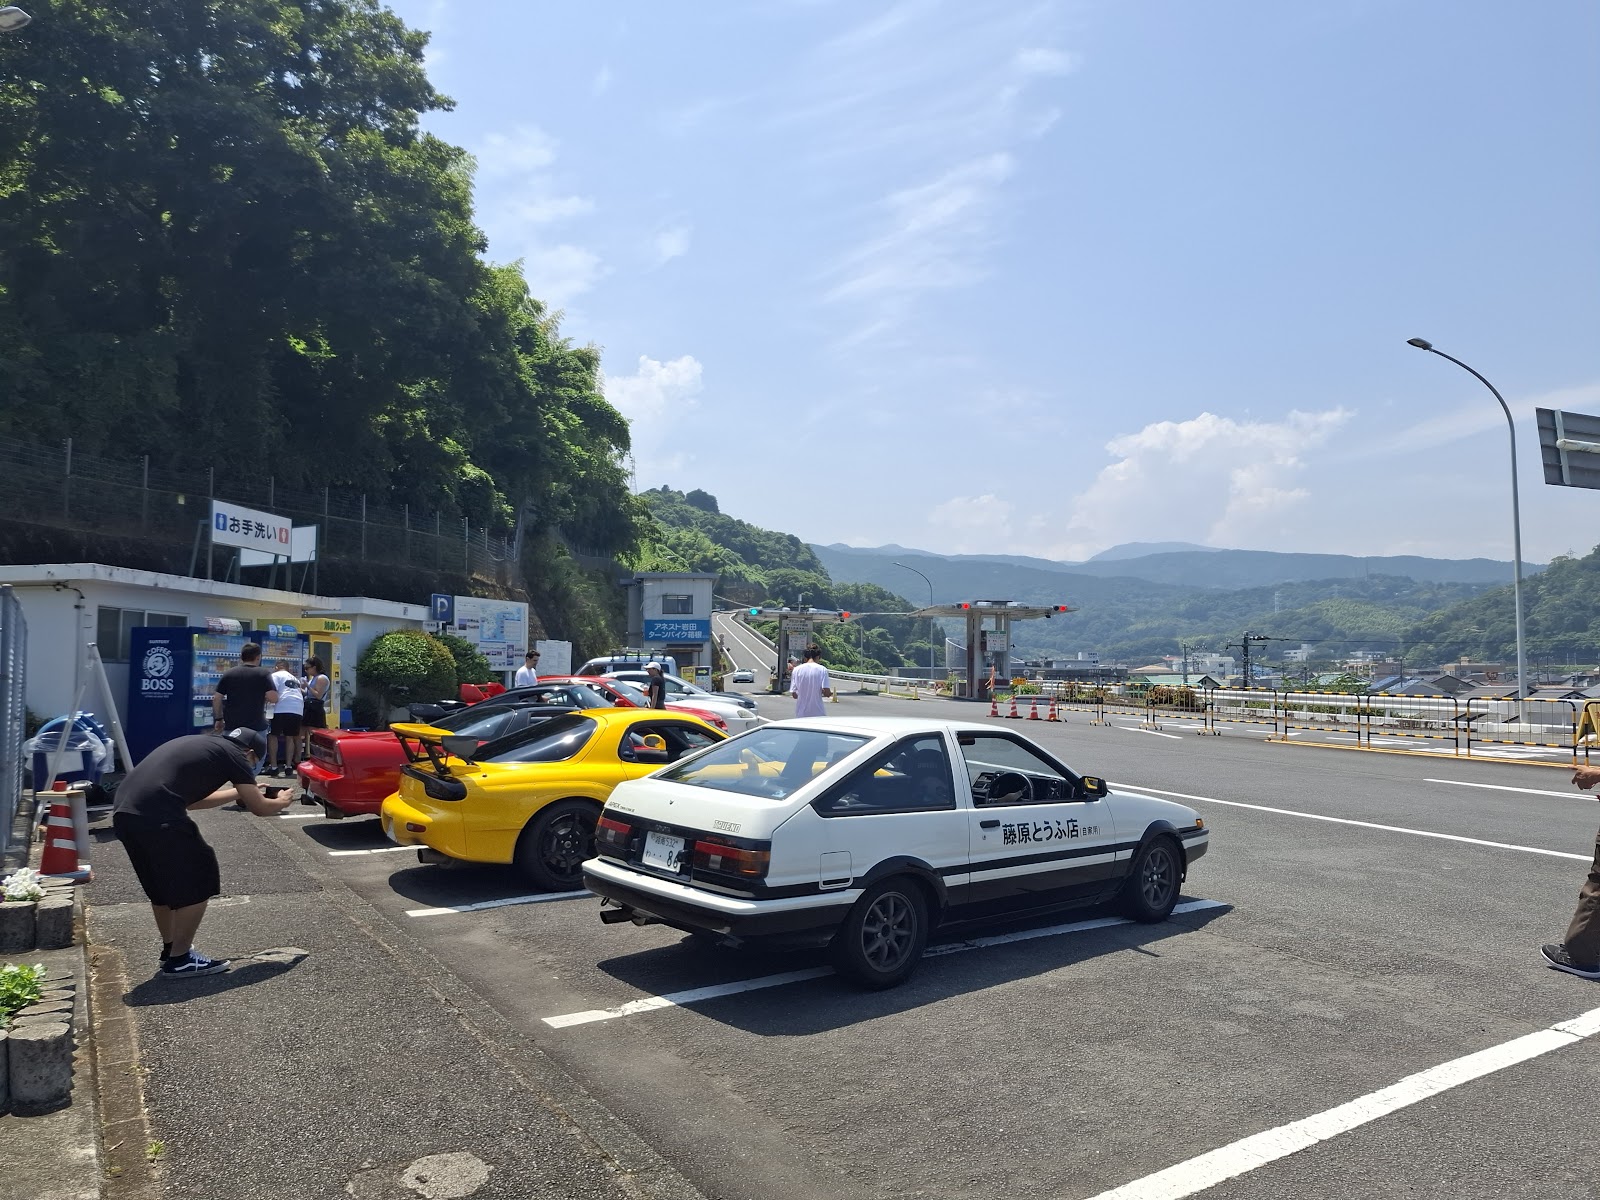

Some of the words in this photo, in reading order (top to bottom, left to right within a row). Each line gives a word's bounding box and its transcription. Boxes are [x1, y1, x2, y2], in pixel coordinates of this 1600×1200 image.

[228, 516, 277, 540] お手洗い
[437, 597, 449, 619] P
[654, 623, 697, 631] アネスト岩田
[648, 631, 703, 639] ターンバイク箱根
[146, 646, 172, 657] COFFEE
[141, 679, 174, 691] BOSS
[713, 819, 742, 834] TRUENO
[1001, 818, 1079, 846] 藤原とうふ店
[666, 850, 679, 869] 86
